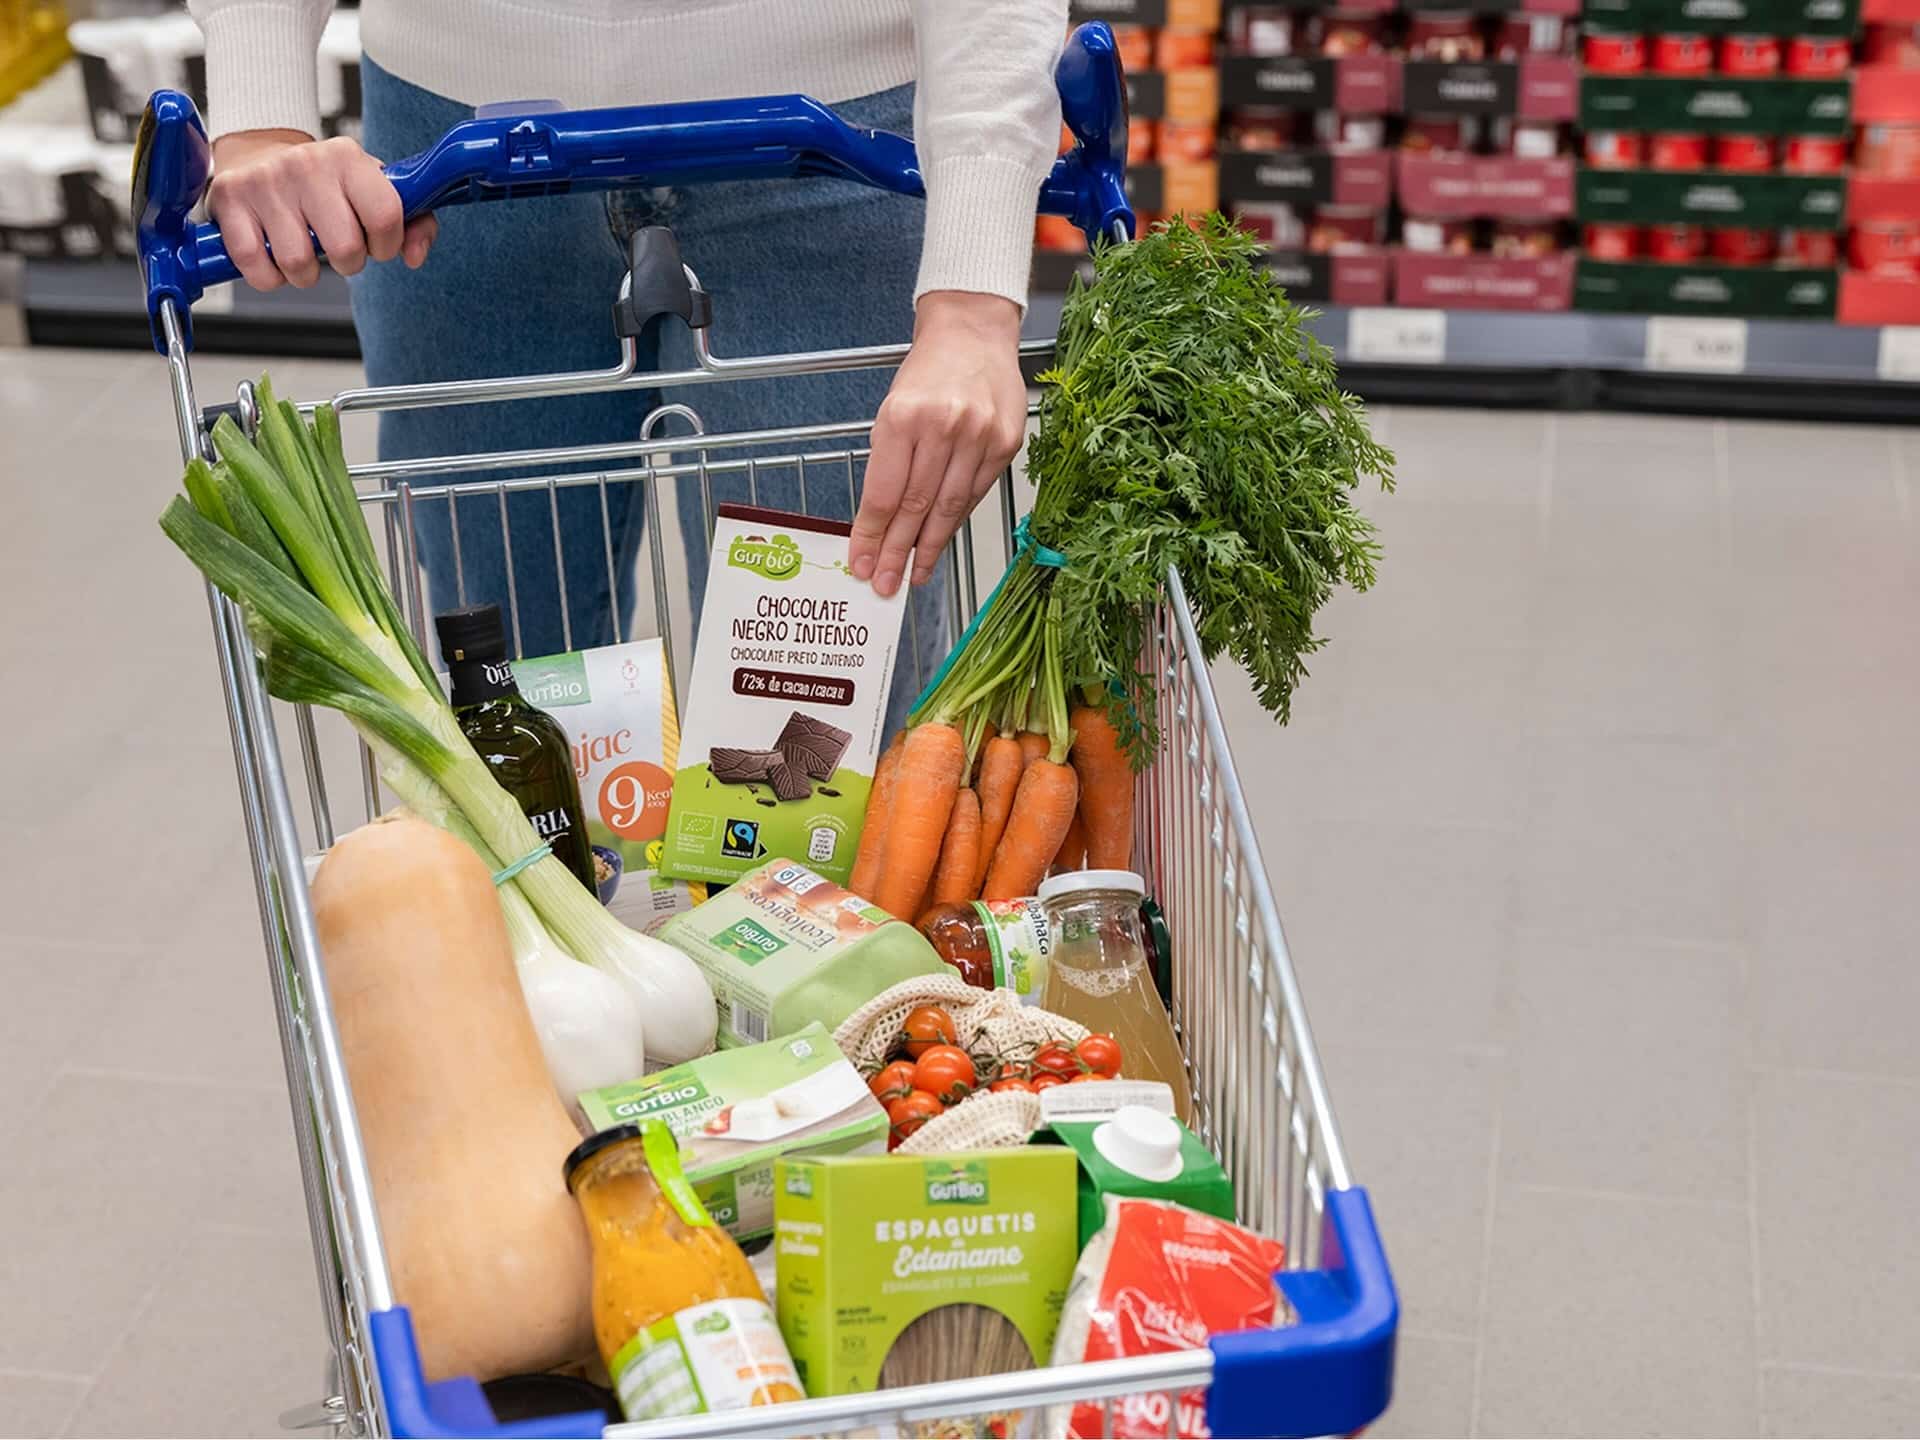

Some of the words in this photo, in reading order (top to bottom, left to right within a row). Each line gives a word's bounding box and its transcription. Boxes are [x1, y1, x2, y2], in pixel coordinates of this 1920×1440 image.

[757, 595, 848, 621] CHOCOLATE
[733, 619, 788, 641] NEGRO
[793, 622, 868, 646] INTENSO
[731, 647, 784, 663] CHOCOLATE
[787, 651, 818, 665] PRETO
[820, 652, 864, 667] INTENSO
[741, 673, 765, 690] 72%
[768, 676, 780, 692] de
[607, 775, 644, 828] 9
[530, 807, 571, 834] RIA
[746, 891, 835, 948] Ecológicos
[735, 924, 778, 952] GUTBIO
[616, 1086, 698, 1116] GUTBIO
[875, 1212, 1036, 1242] ESPAGUETIS
[893, 1245, 1023, 1278] Edamame
